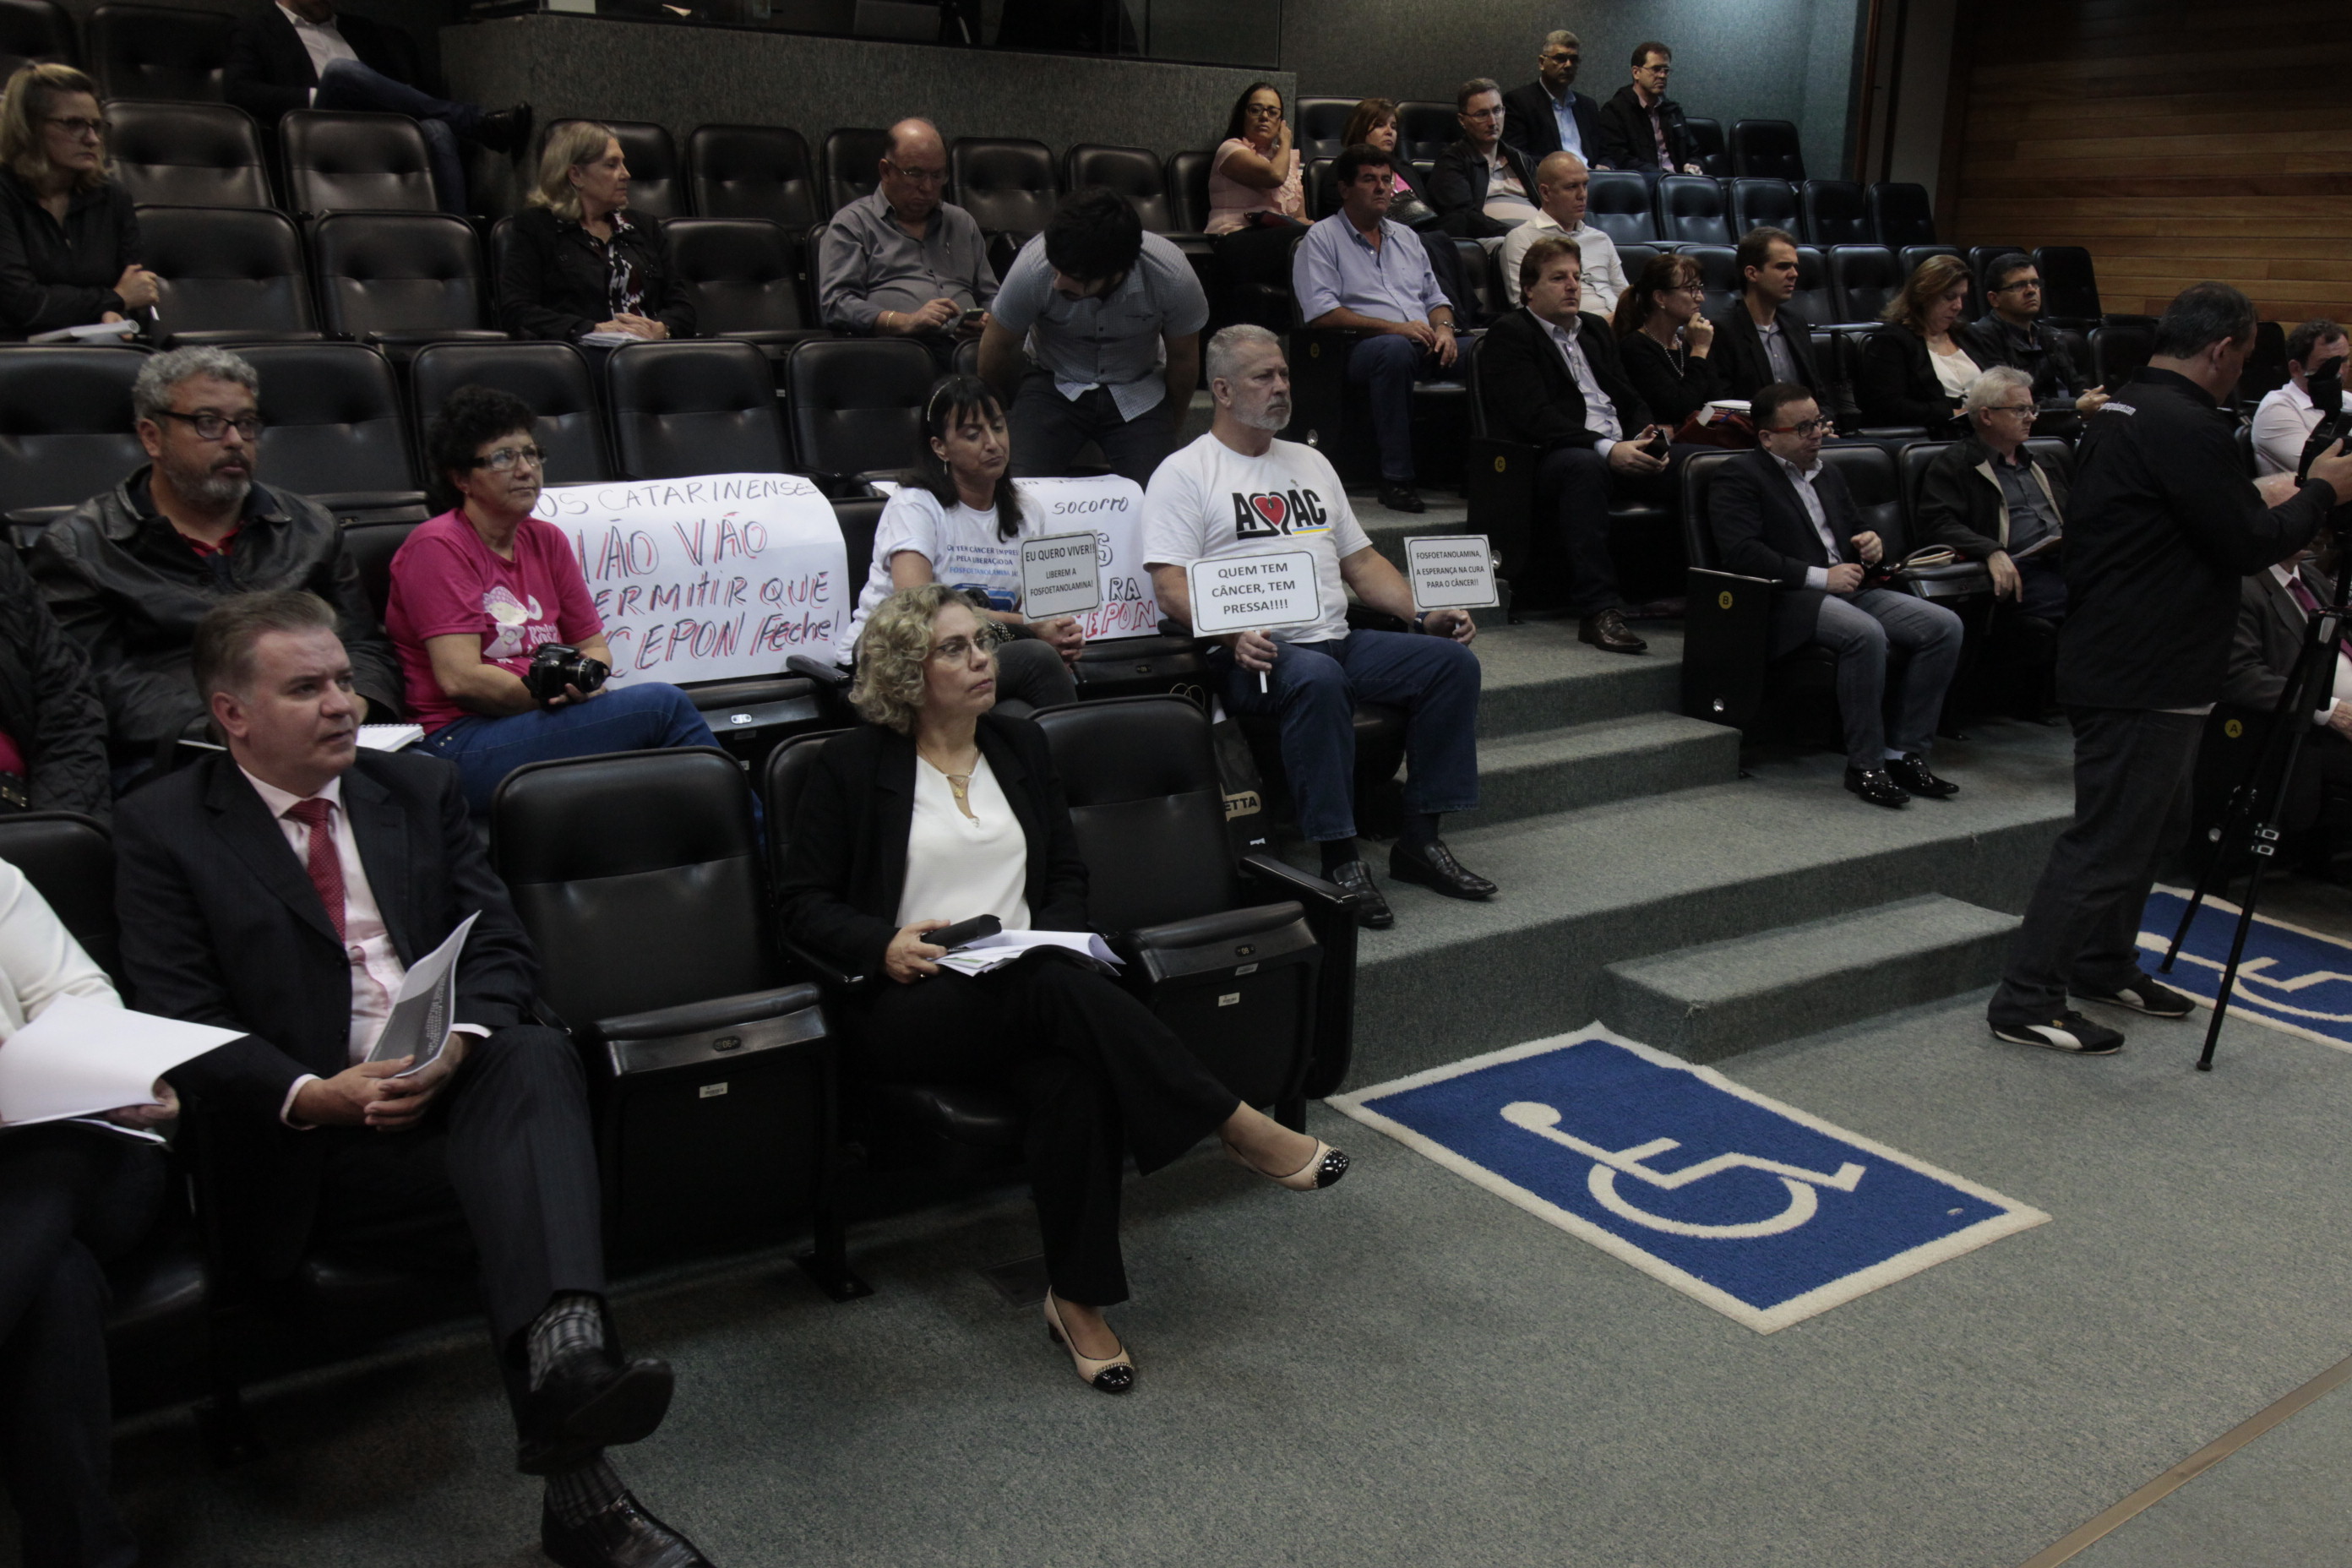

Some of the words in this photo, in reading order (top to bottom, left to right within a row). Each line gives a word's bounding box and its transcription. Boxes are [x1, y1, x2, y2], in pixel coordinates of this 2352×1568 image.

[536, 493, 589, 517] OS
[598, 480, 817, 511] CATARINENSES
[672, 512, 767, 565] VÃO
[1026, 551, 1036, 562] EU
[1037, 547, 1065, 561] QUERO
[1067, 543, 1095, 557] VIVER!!
[1416, 550, 1482, 559] FOSFOETANOLAMINA,
[1046, 568, 1070, 580] LIBEREM
[1217, 565, 1257, 579] QUEM
[1260, 563, 1288, 574] TEM
[1422, 566, 1457, 575] ESPERANÇA
[1468, 565, 1485, 574] CURA
[1030, 580, 1093, 597] FOSFOETANOLAMINA!
[1211, 584, 1266, 597] CÂNCER,
[1268, 580, 1296, 592] TEM
[1451, 578, 1479, 587] CÂNCER!!
[594, 570, 748, 620] ERMITIR
[760, 571, 829, 609] QUE
[1723, 595, 1729, 605] B
[1223, 598, 1289, 615] PRESSA!!!!
[2230, 723, 2238, 734] A
